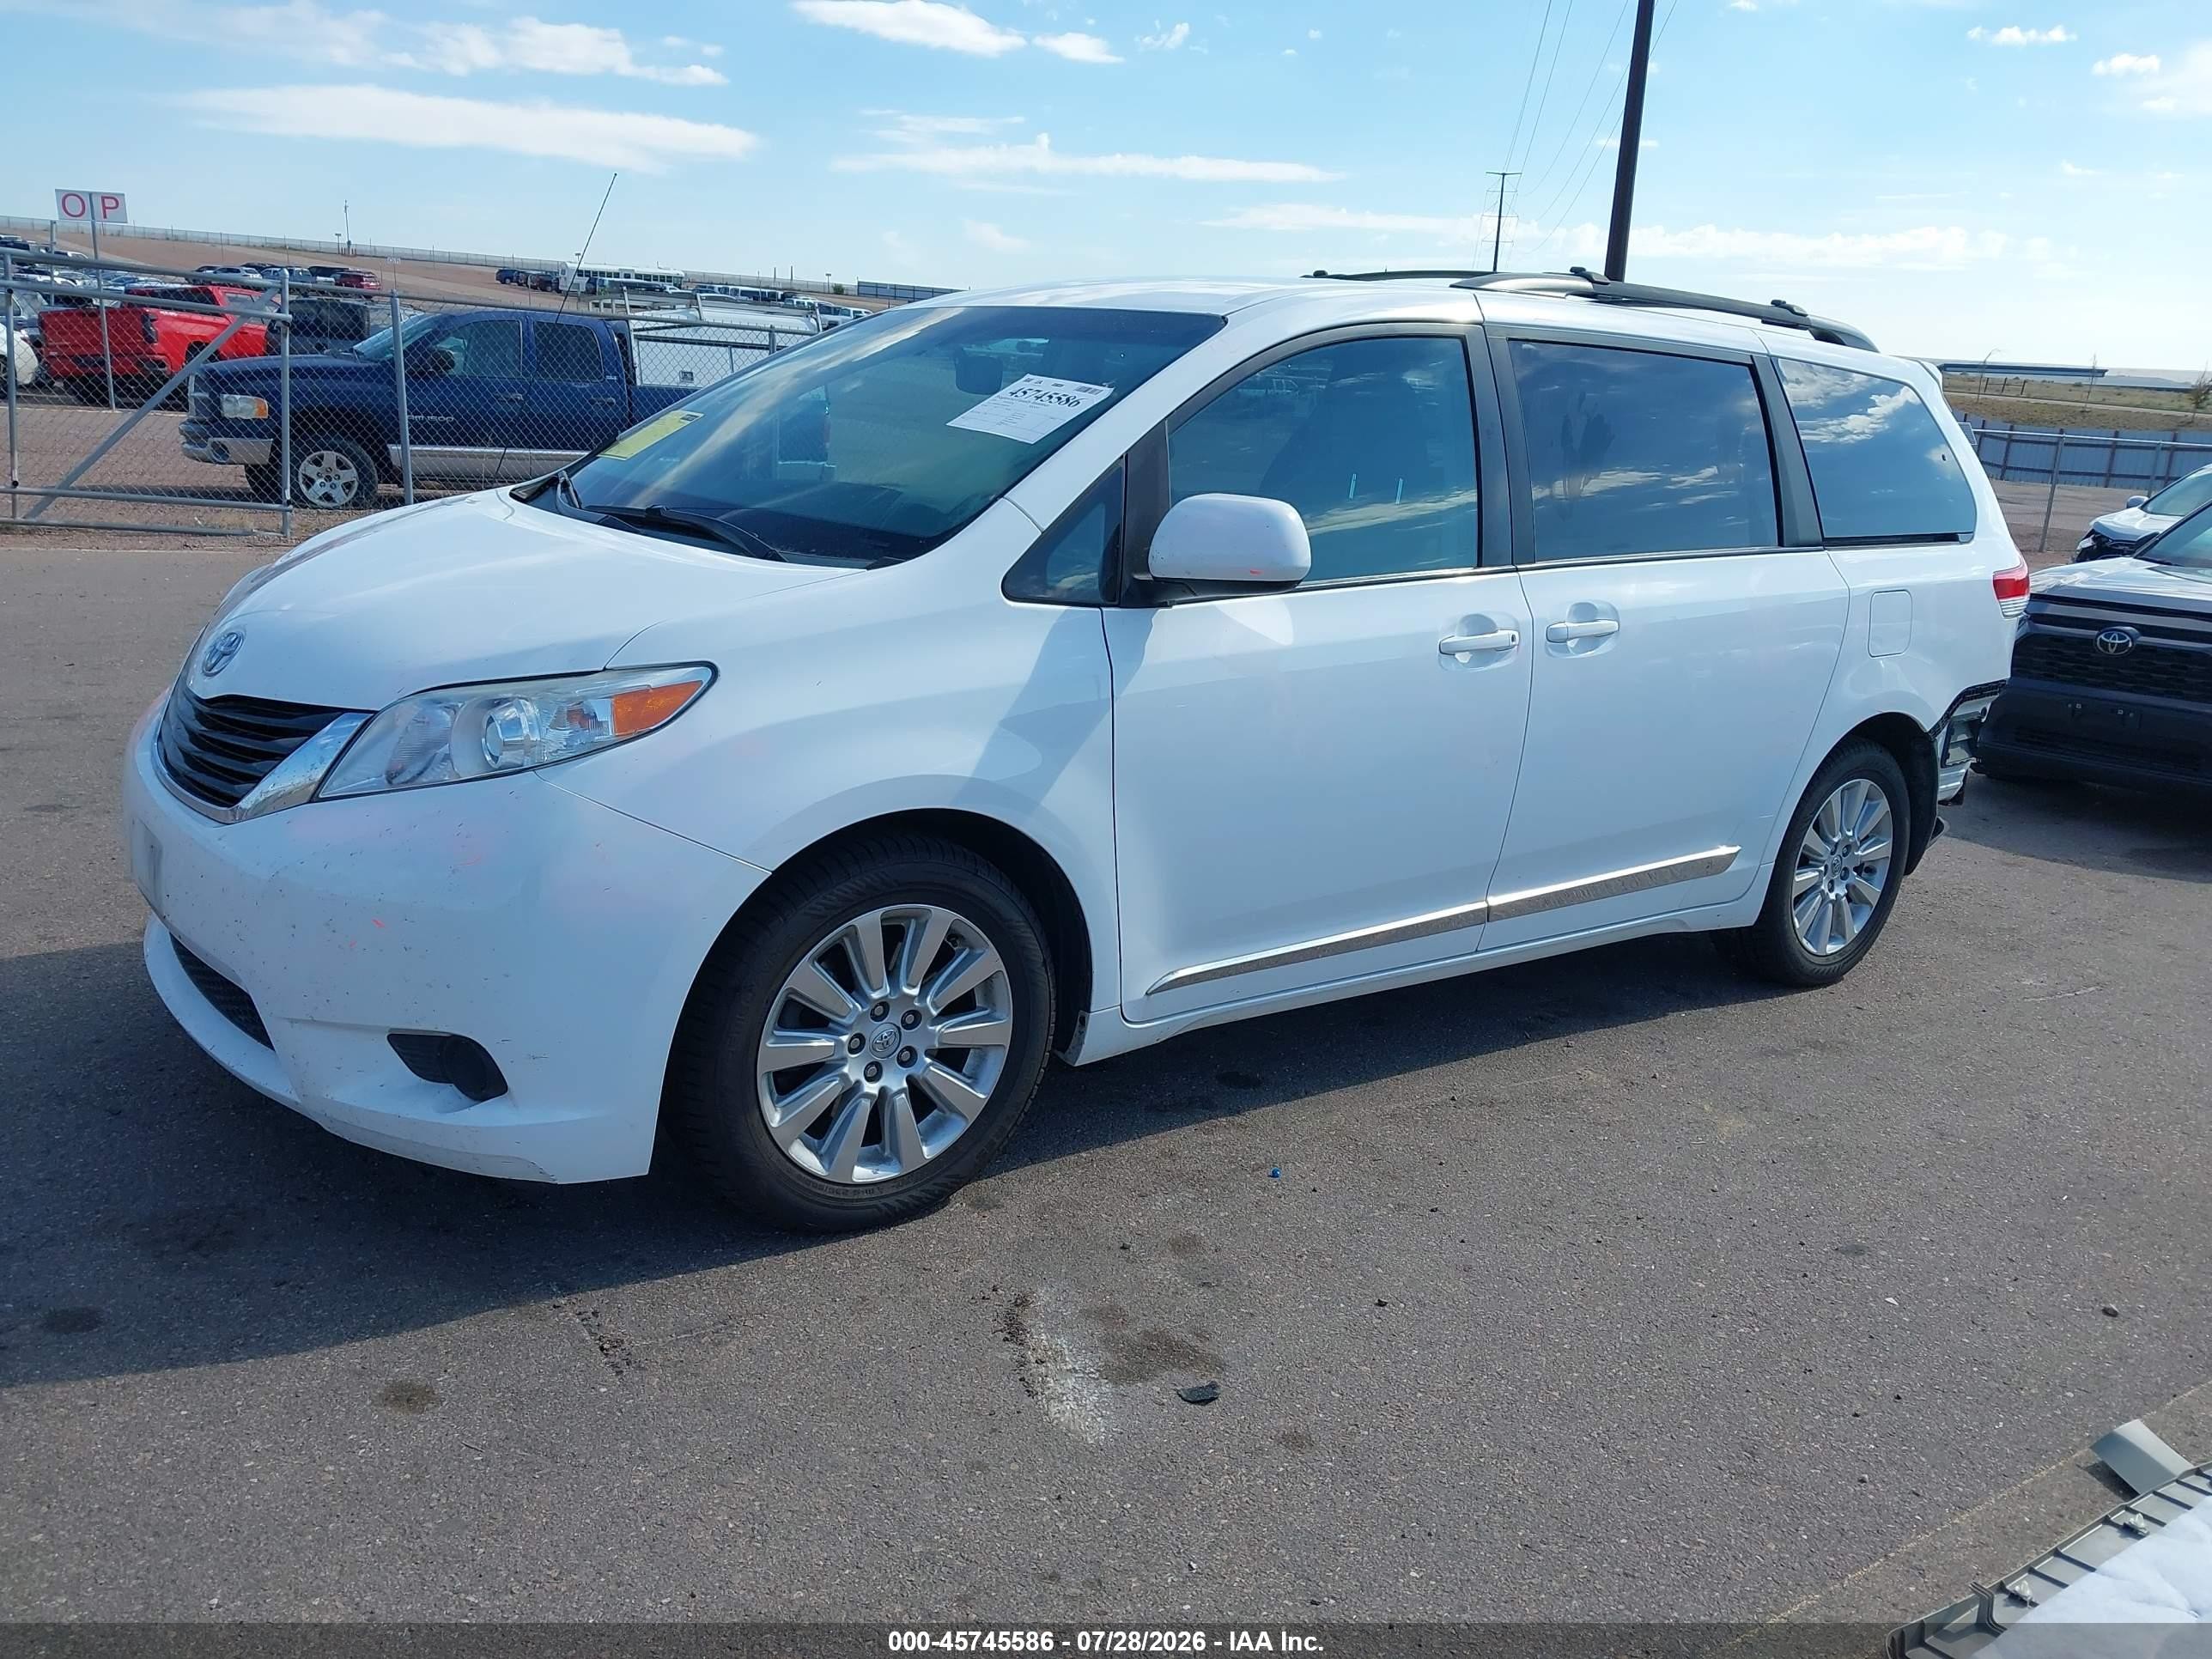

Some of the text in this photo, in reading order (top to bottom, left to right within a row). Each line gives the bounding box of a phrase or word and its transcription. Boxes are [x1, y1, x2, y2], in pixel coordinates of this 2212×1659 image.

[62, 192, 119, 219] O P
[1008, 386, 1086, 408] 45745586
